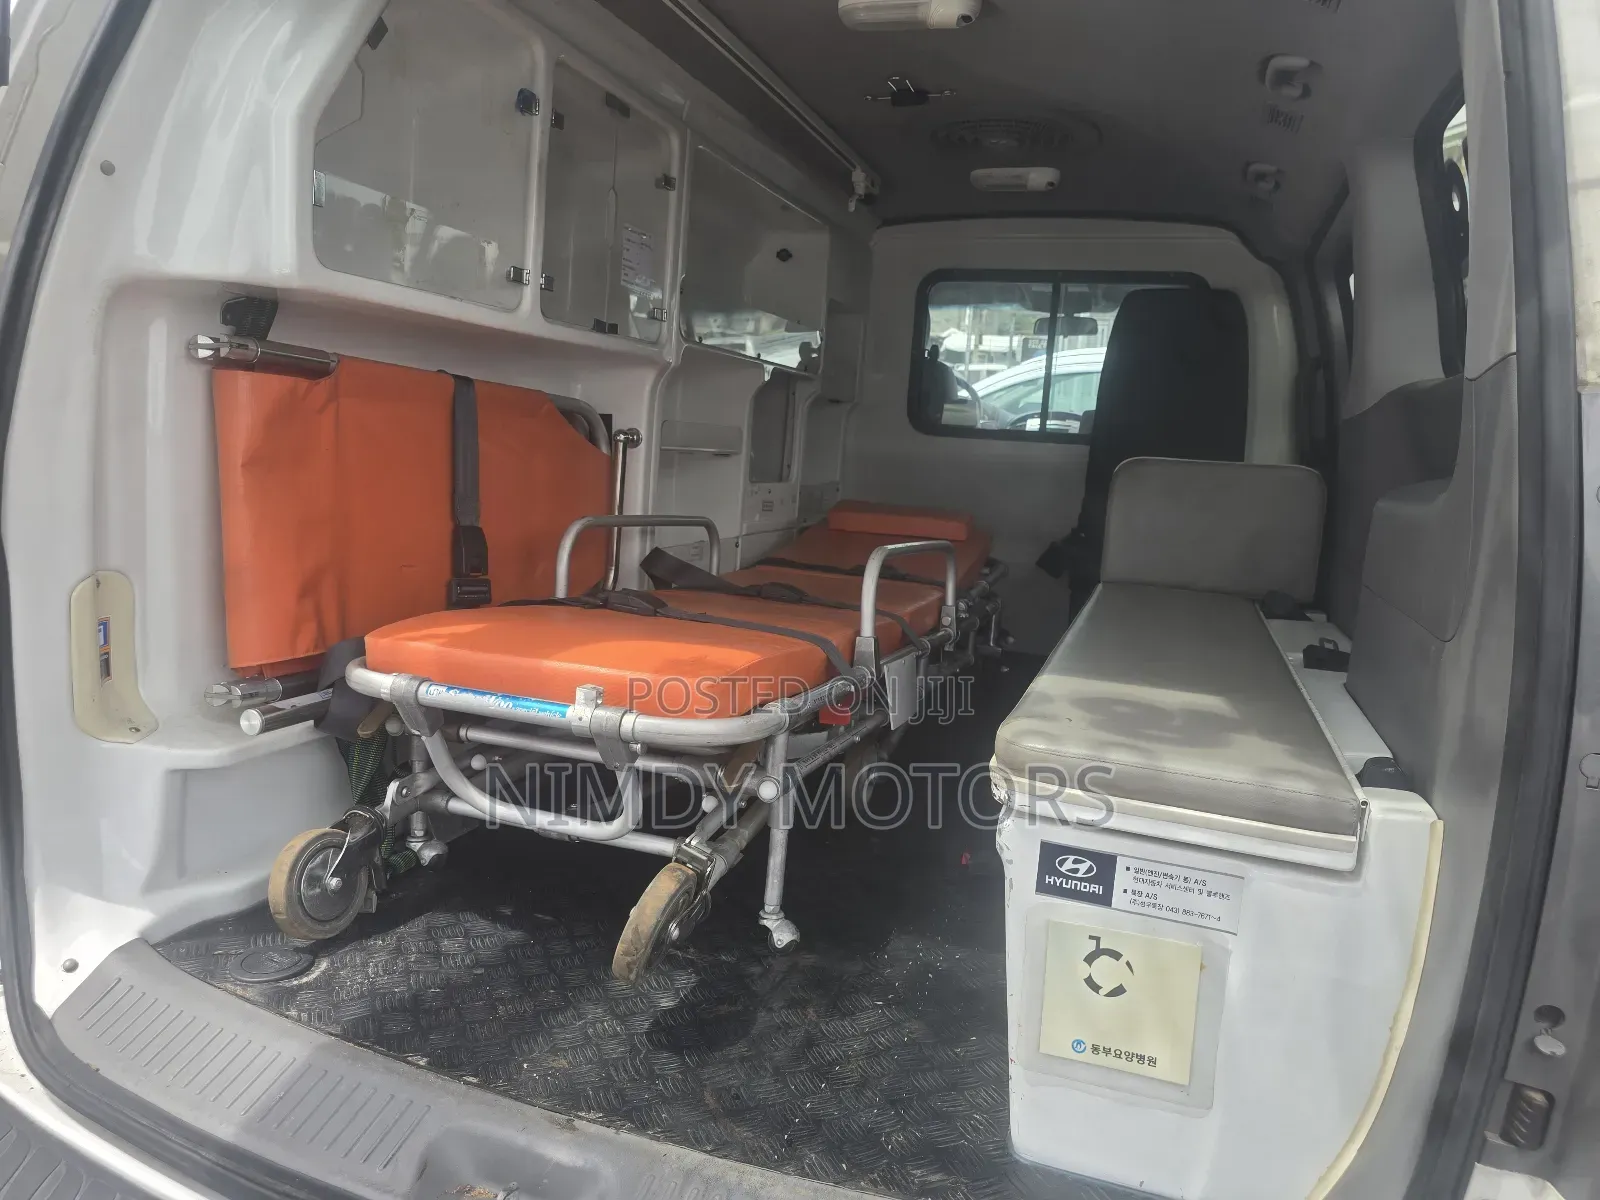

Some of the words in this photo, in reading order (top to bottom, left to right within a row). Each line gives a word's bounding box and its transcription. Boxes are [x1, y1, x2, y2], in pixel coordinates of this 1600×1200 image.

[1045, 875, 1104, 895] HYUNDAI
[1193, 878, 1207, 887] A/S
[1144, 892, 1158, 901] A/S
[1090, 1043, 1157, 1068] 동부요양병원
